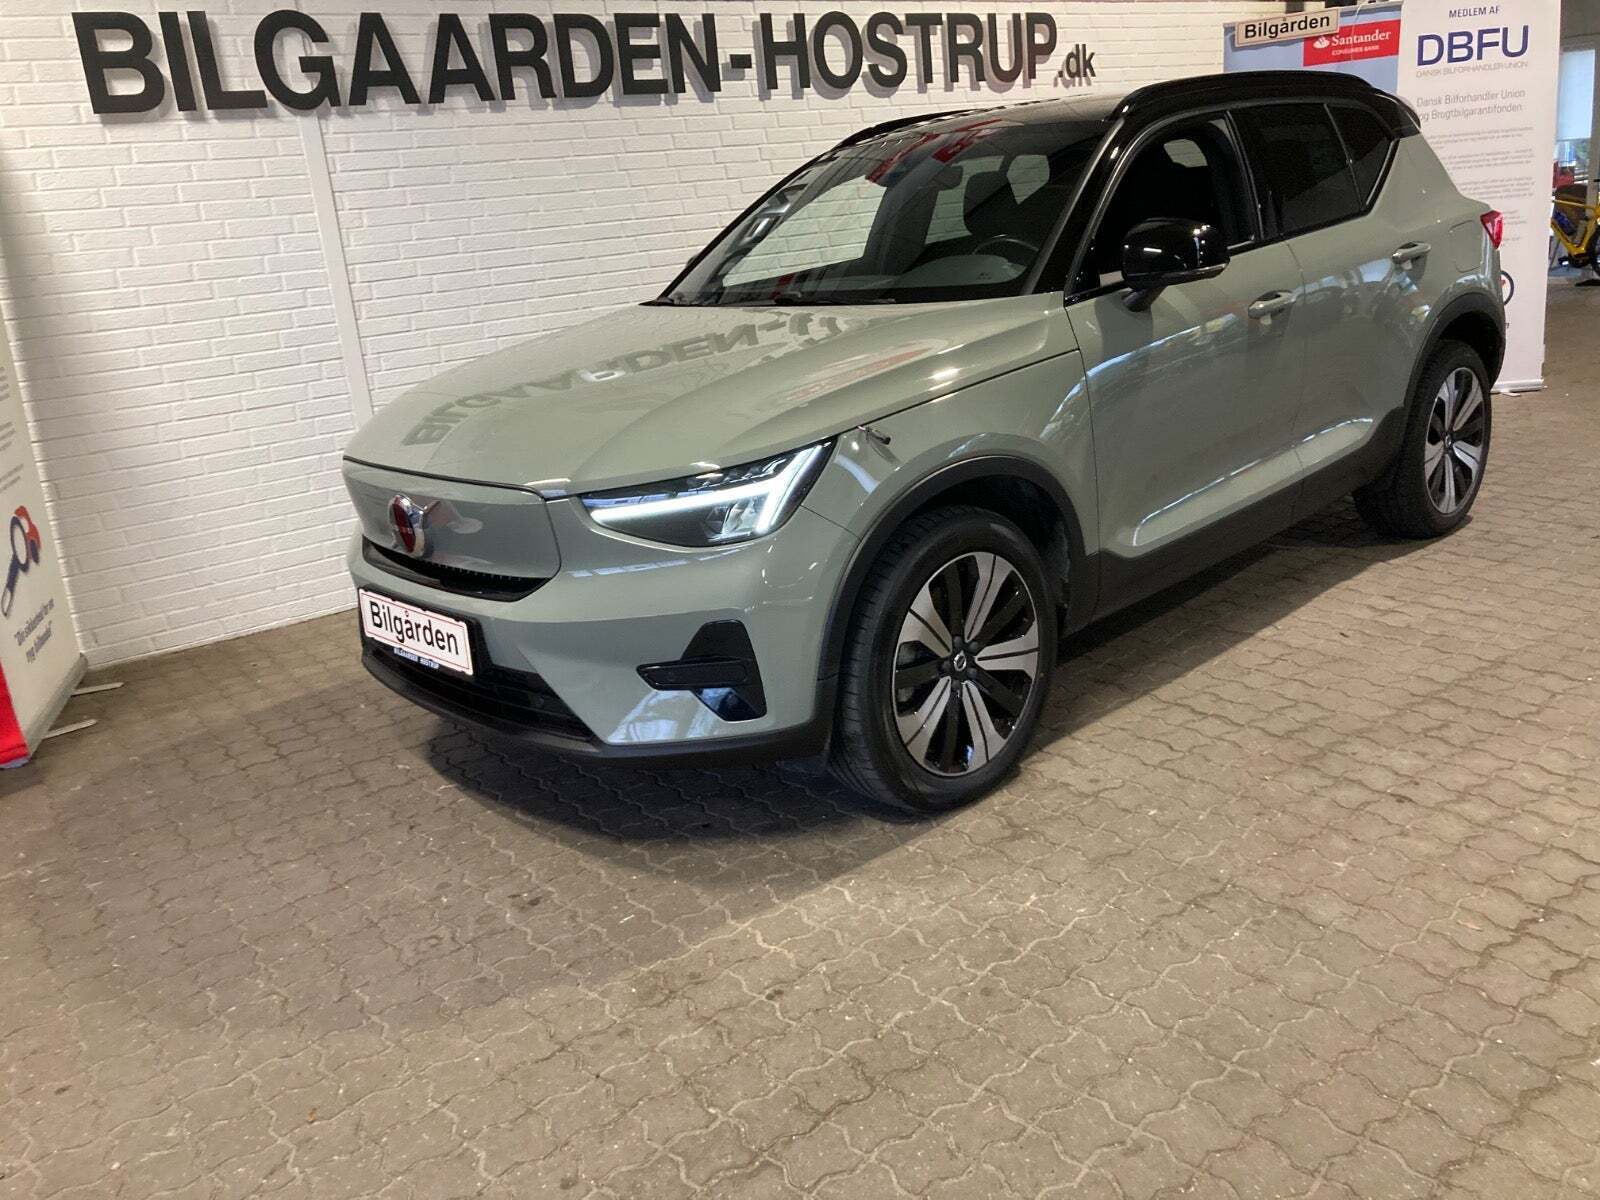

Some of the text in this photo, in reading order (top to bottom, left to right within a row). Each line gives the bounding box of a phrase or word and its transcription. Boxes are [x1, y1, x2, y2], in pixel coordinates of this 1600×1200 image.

[1448, 5, 1500, 18] MEDLEM AF
[1331, 30, 1392, 47] Santander
[1417, 25, 1529, 66] DBFU
[368, 600, 459, 656] Bilgården
